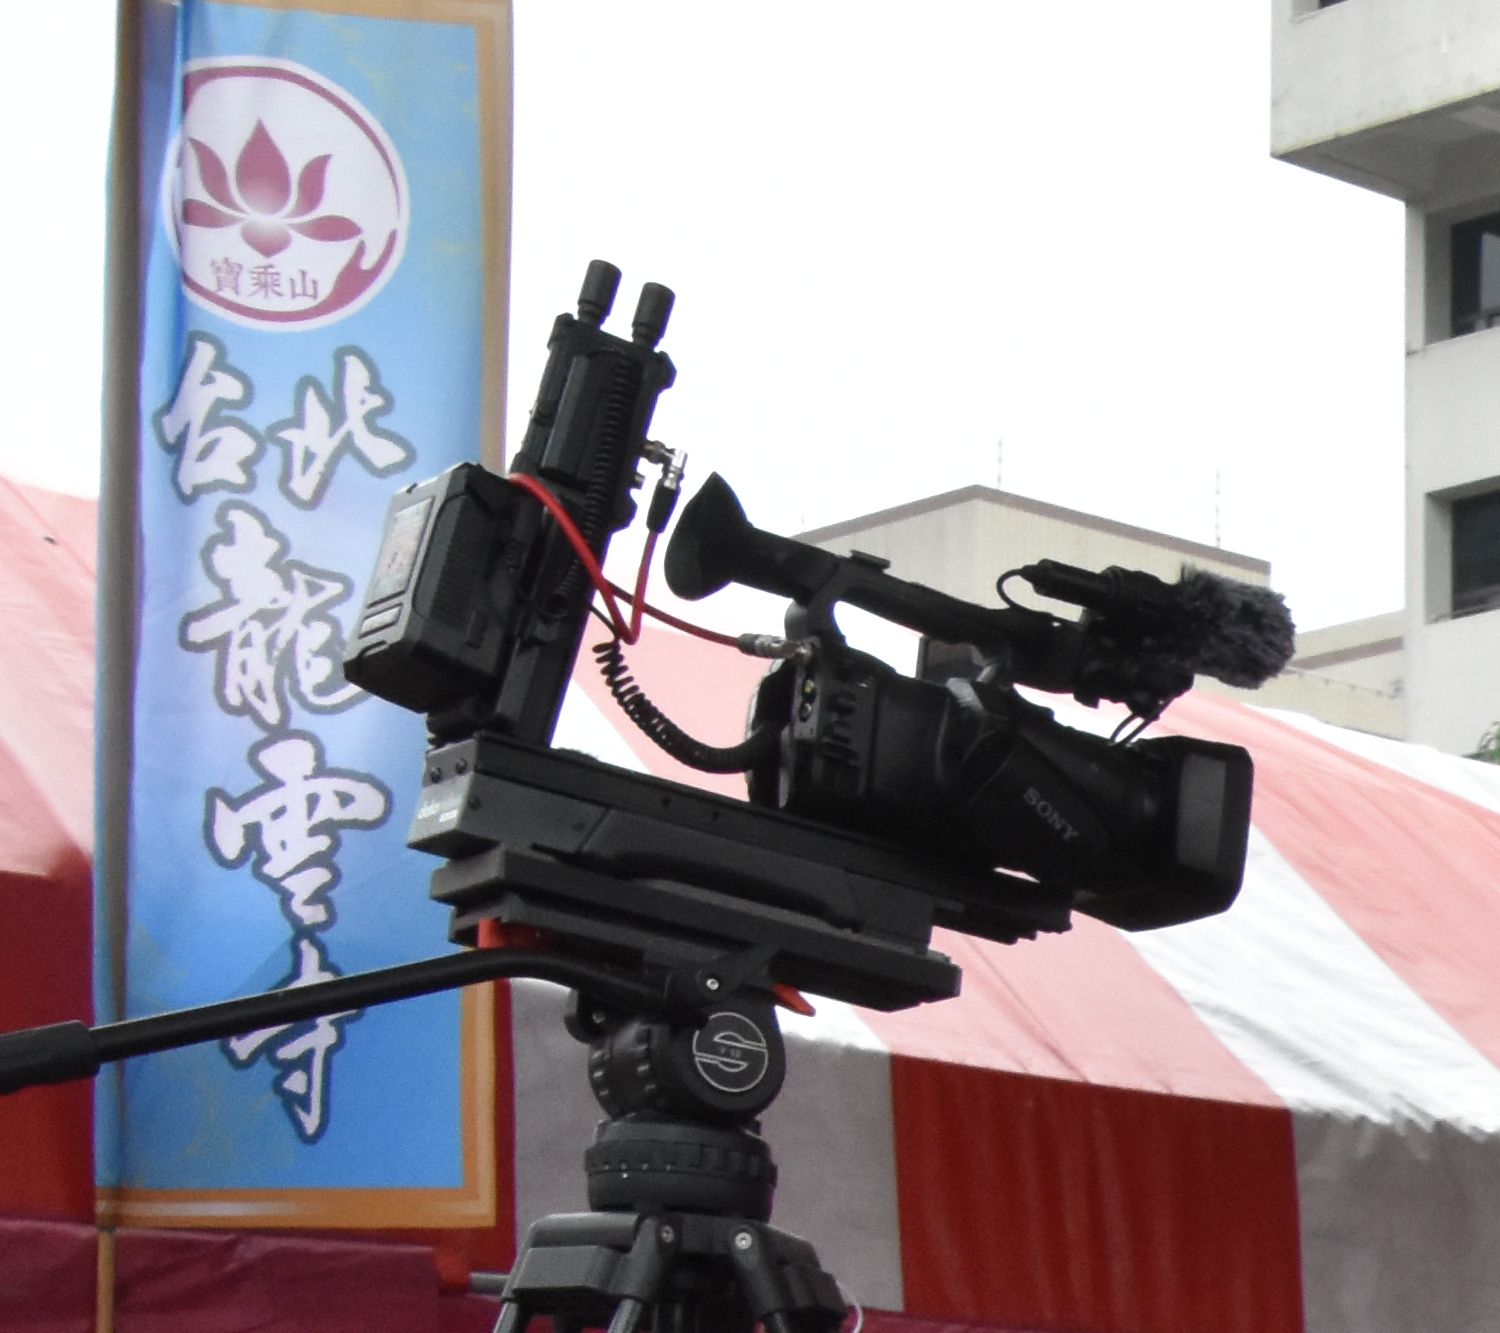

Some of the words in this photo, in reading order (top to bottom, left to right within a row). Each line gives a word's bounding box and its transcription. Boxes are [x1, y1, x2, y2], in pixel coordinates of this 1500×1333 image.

[208, 256, 321, 303] 寶乘山
[1024, 786, 1080, 841] SONY
